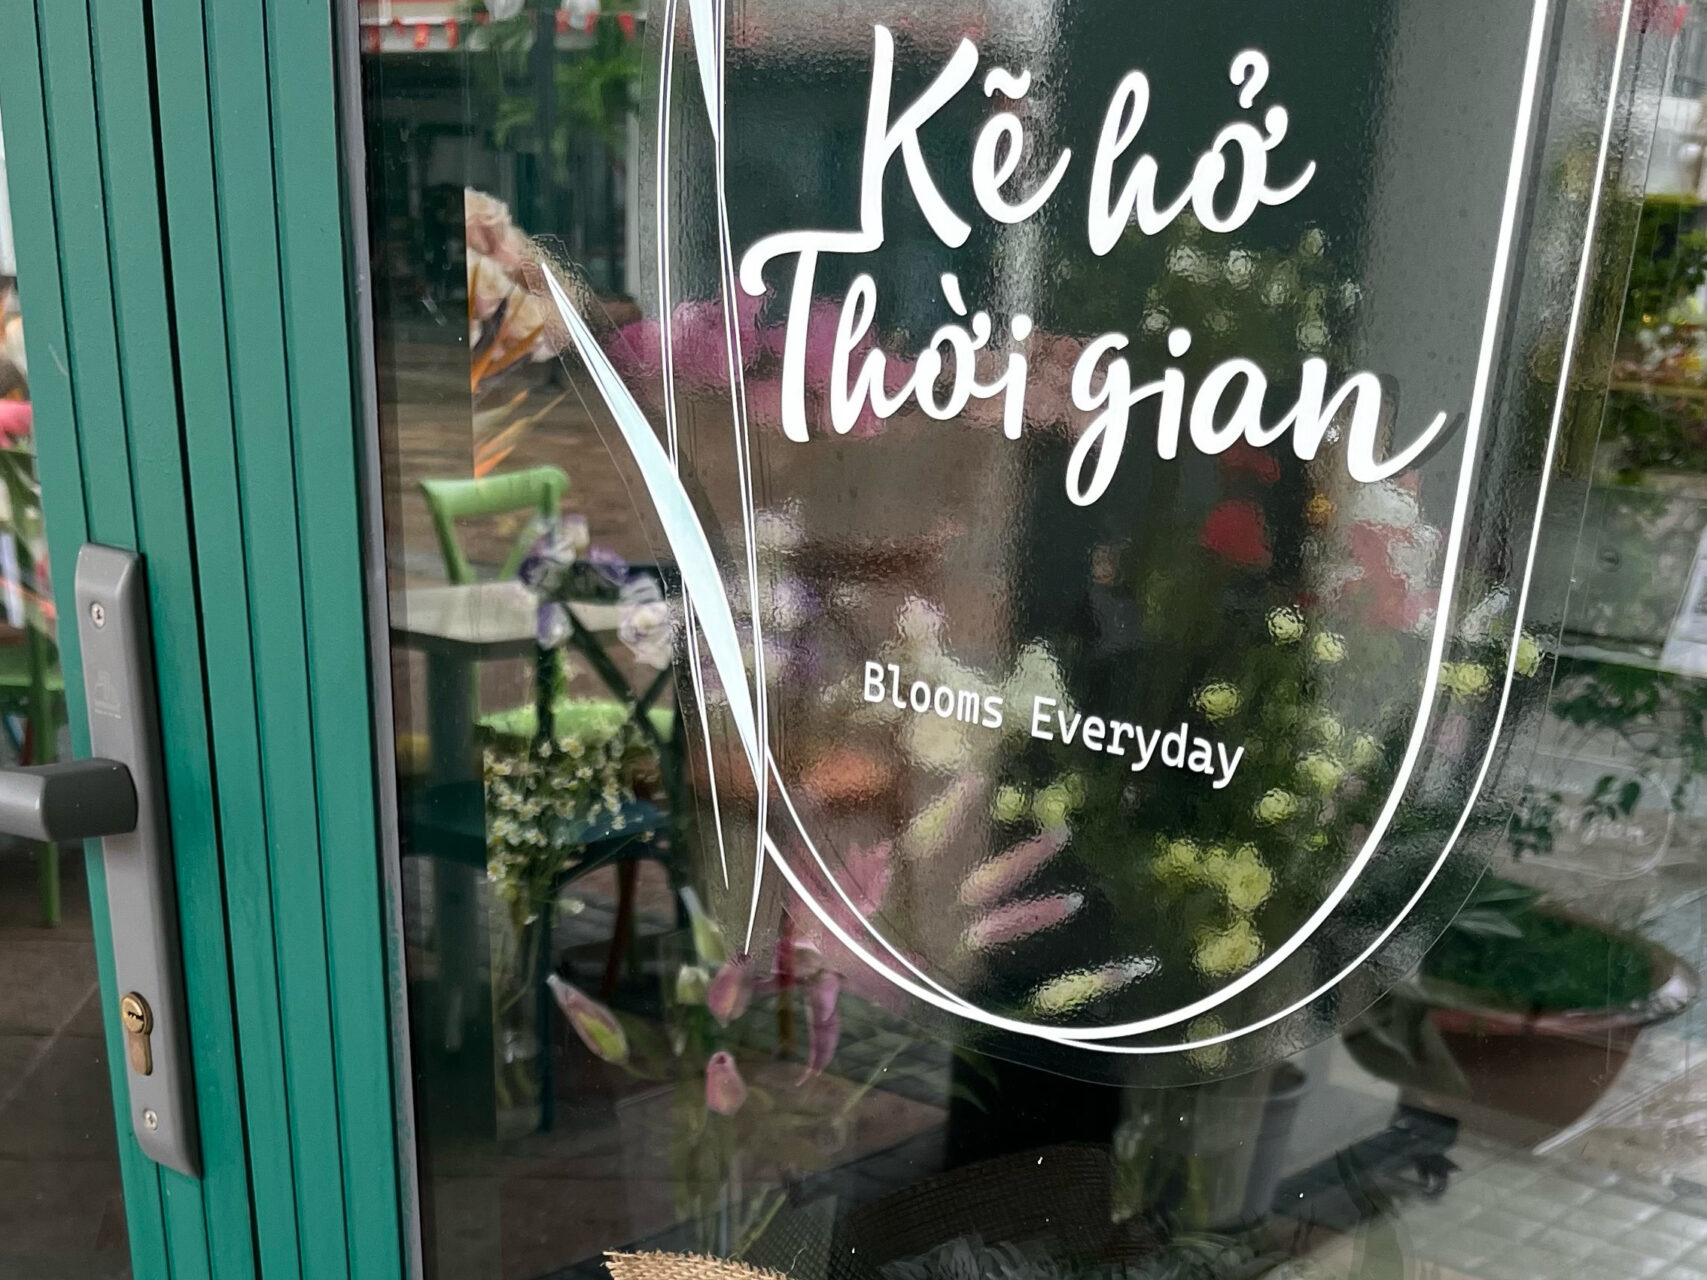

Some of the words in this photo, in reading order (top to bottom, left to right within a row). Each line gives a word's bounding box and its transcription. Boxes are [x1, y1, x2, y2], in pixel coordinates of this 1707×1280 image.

[861, 24, 1072, 249] Kẽ
[1088, 50, 1316, 256] hở
[740, 229, 1031, 443] Thời
[1065, 328, 1447, 507] gian
[863, 661, 1004, 729] Blooms
[1030, 695, 1245, 789] Everyday
